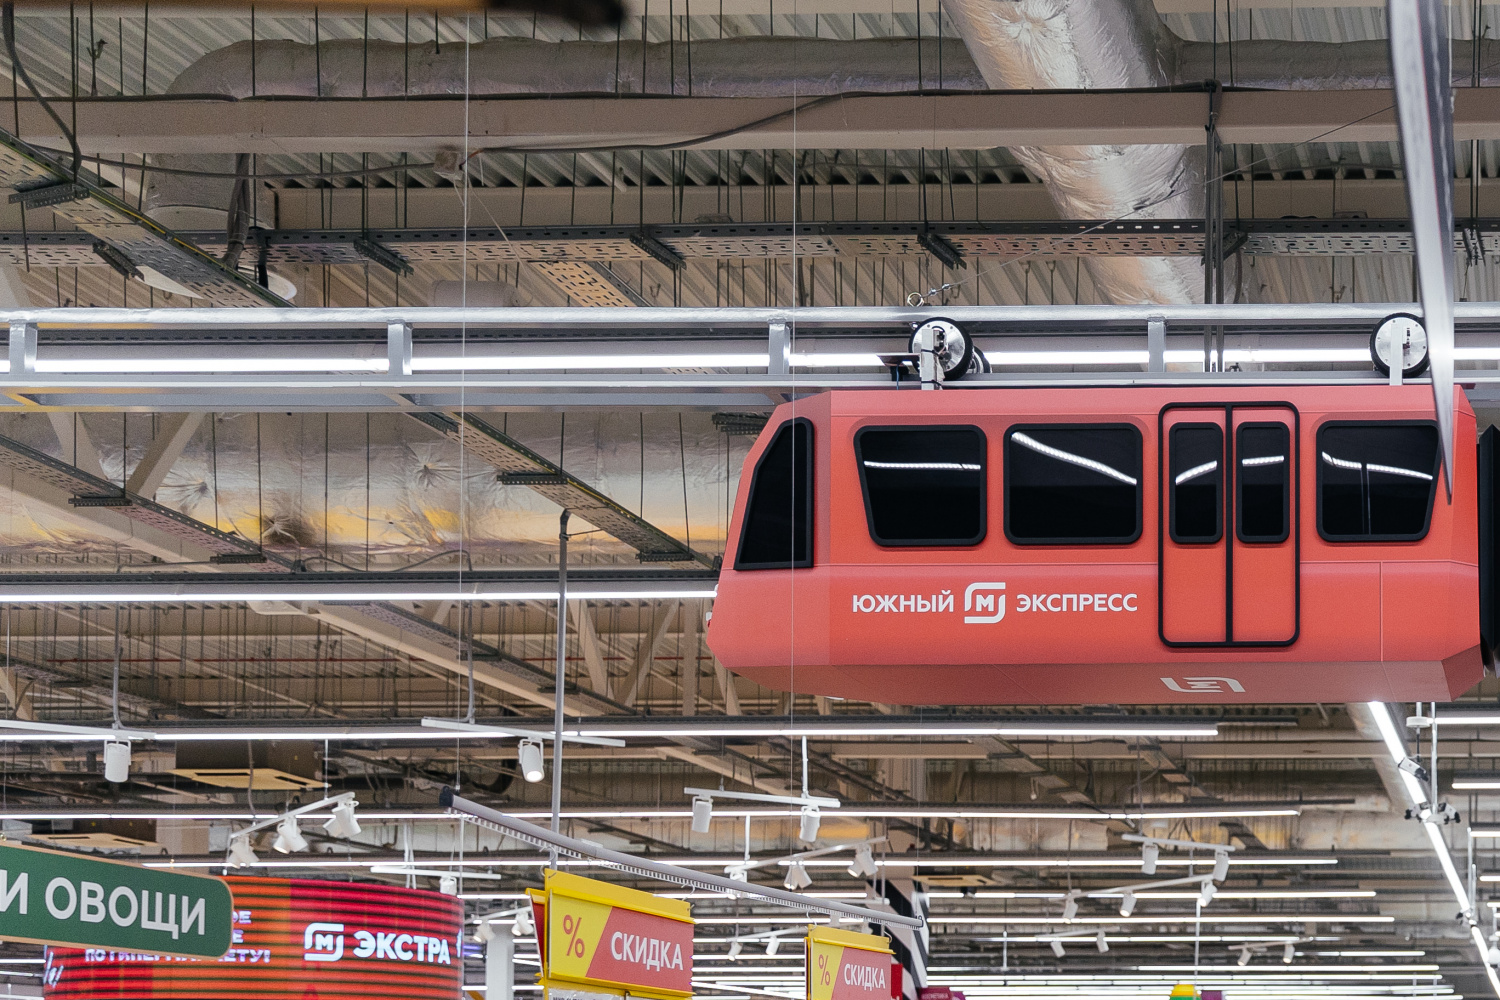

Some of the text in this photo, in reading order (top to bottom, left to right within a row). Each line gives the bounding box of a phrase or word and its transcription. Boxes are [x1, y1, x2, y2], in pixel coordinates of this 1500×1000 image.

[852, 589, 954, 613] ЮЖНЫЙ
[1017, 593, 1138, 613] ЭКСПРЕСС
[0, 869, 205, 940] И ОВОЩИ
[353, 930, 451, 964] ЭКСТРА
[610, 931, 684, 972] СКИДКА
[843, 963, 887, 992] СКИДКА
